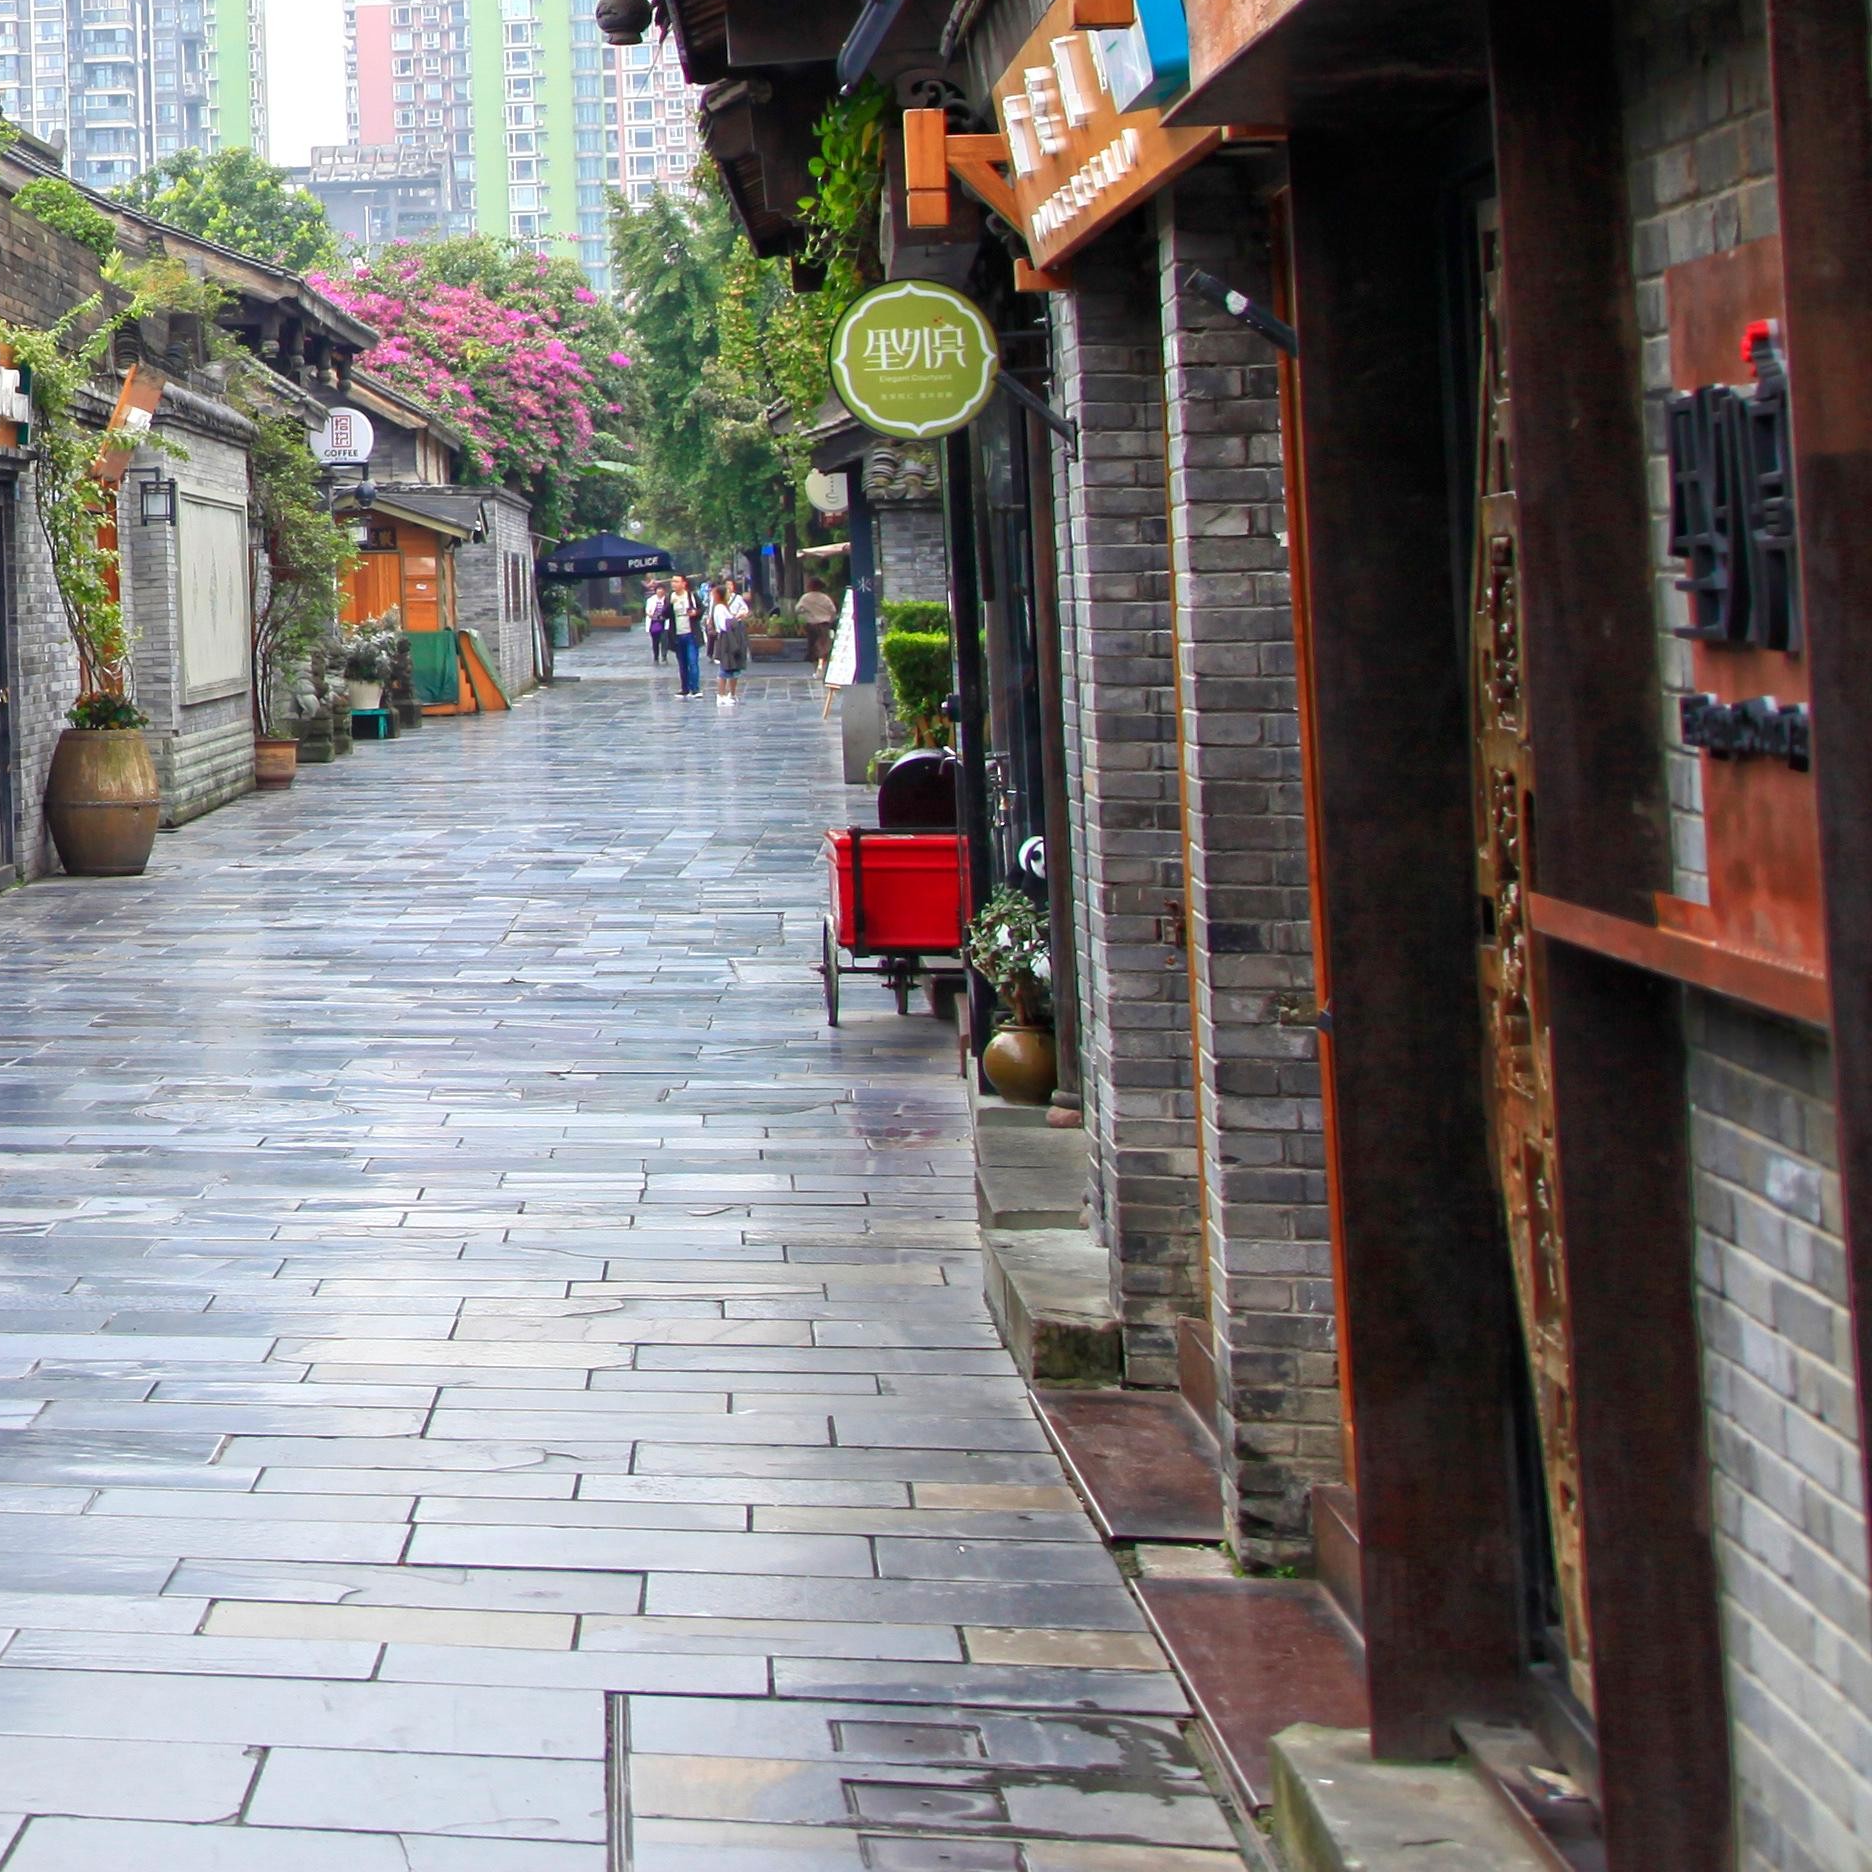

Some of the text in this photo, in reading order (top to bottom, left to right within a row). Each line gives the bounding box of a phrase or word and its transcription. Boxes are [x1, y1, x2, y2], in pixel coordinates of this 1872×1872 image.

[879, 373, 953, 384] Elegant Courtyard
[324, 449, 359, 458] COFFEE
[628, 556, 659, 569] POLICE
